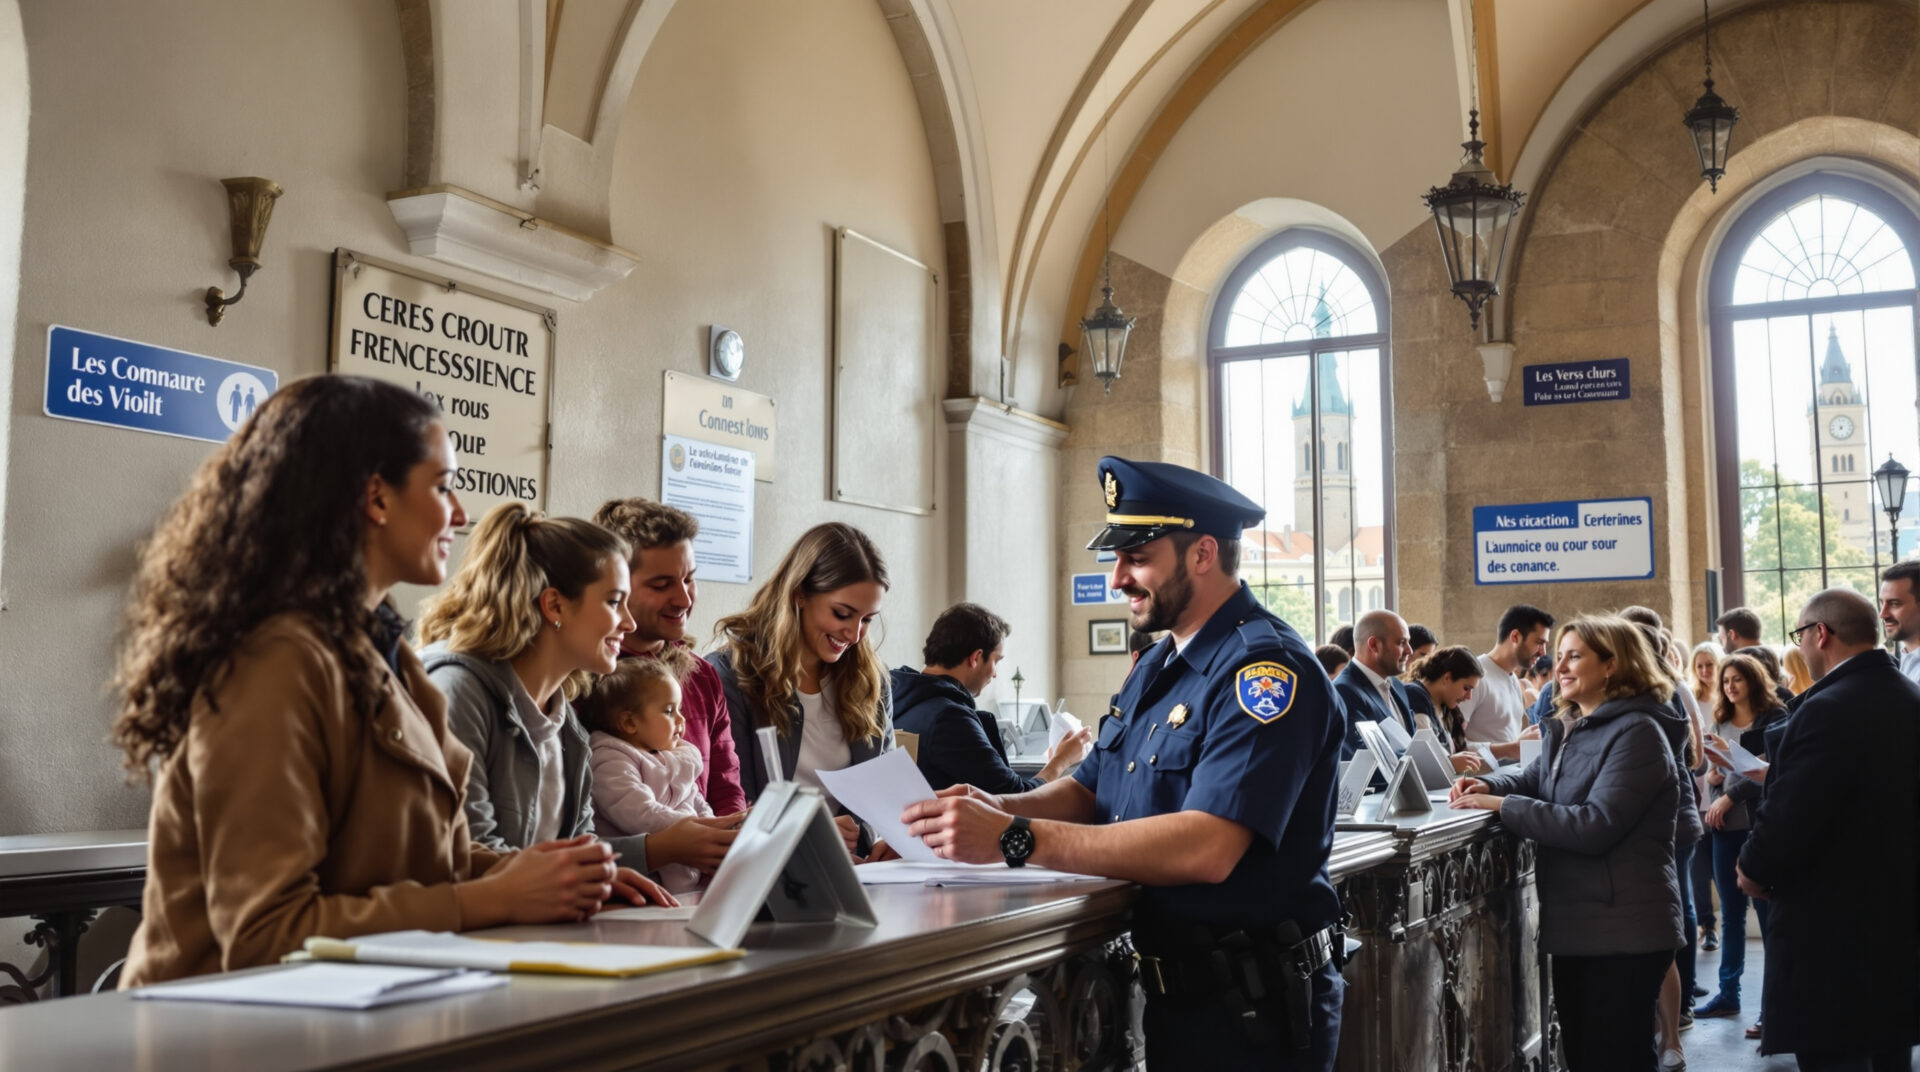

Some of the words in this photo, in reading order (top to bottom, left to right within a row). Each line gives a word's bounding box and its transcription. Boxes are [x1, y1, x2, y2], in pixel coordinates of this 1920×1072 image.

[363, 292, 434, 333] CERES
[441, 312, 529, 358] CROUTR
[72, 347, 107, 375] Les
[350, 328, 537, 396] FRENCESSSIENCE
[1535, 370, 1554, 383] Les
[67, 378, 103, 406] des
[109, 385, 163, 416] Vioilt
[451, 397, 490, 420] rous
[454, 467, 537, 500] SSTIONES
[1545, 541, 1559, 552] ou
[1592, 539, 1618, 550] sour
[1487, 559, 1507, 573] des
